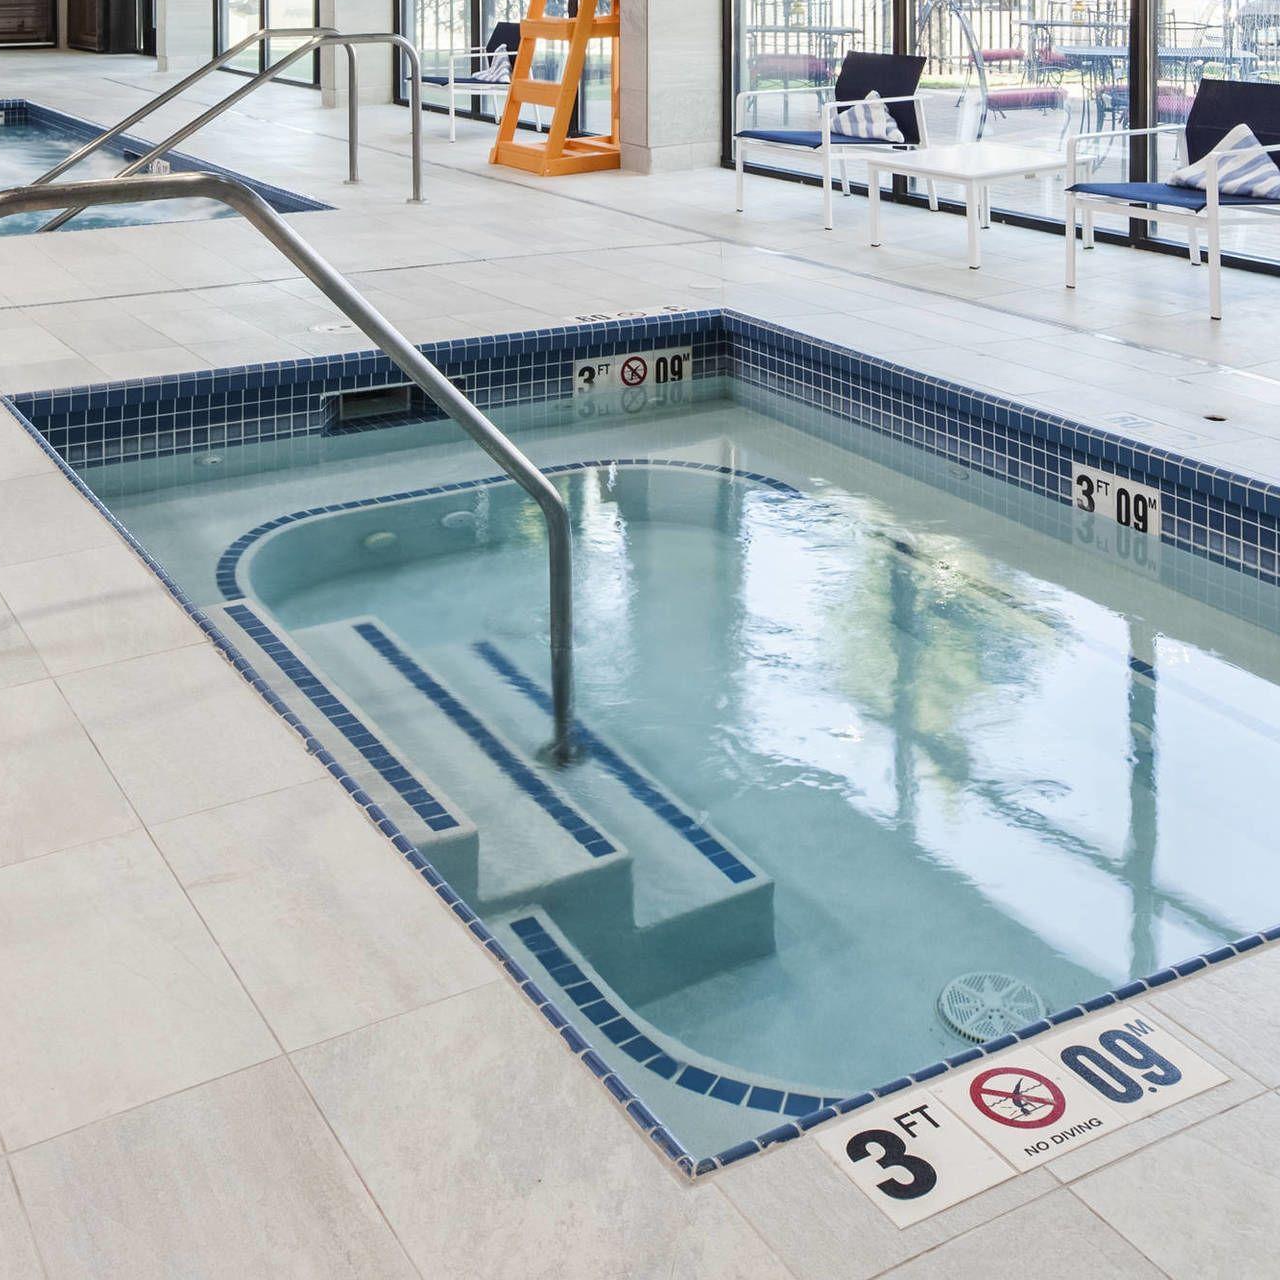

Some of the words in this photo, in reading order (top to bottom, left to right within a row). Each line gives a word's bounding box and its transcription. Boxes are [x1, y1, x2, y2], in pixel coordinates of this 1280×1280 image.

[597, 363, 610, 375] FT
[1076, 474, 1095, 513] 3
[1096, 479, 1110, 497] FT
[1148, 497, 1158, 511] M
[846, 1128, 938, 1200] 3
[893, 1104, 941, 1139] FT
[1123, 1019, 1155, 1037] M
[1024, 1135, 1050, 1157] NO
[1053, 1116, 1104, 1145] DIVING
